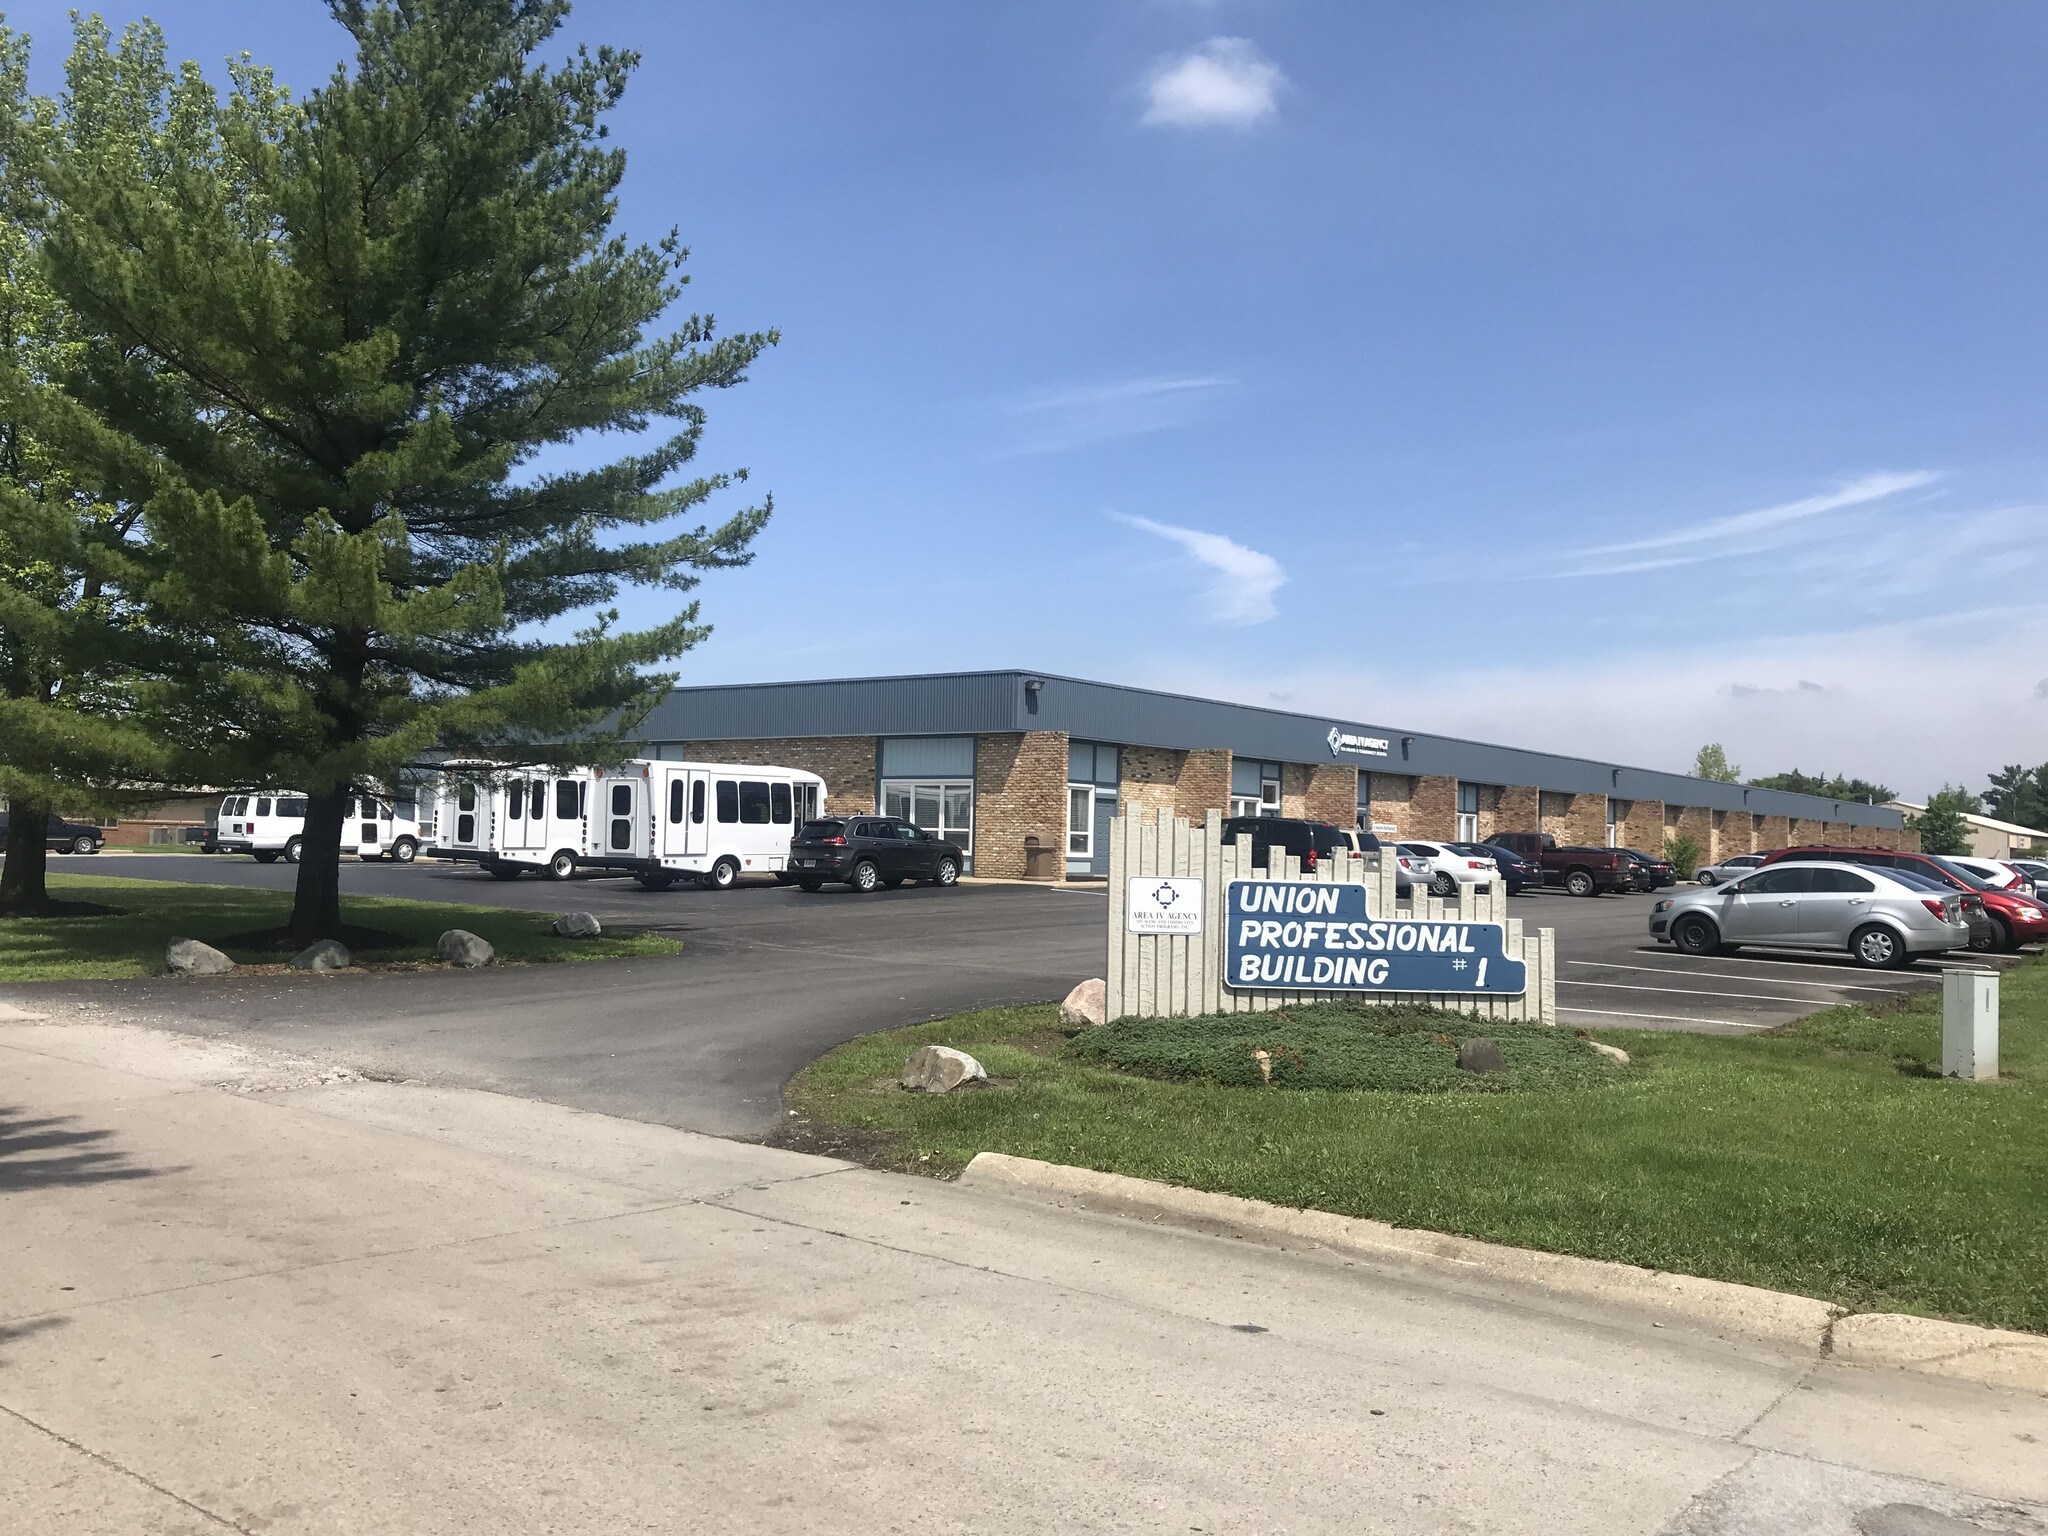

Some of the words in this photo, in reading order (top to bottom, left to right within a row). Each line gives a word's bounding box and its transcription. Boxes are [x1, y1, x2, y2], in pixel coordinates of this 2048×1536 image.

[1239, 884, 1340, 914] UNION
[1132, 911, 1153, 919] AREA
[1167, 912, 1198, 920] AGENCY
[1238, 920, 1476, 953] PROFESSIONAL
[1239, 954, 1390, 985] BUILDING
